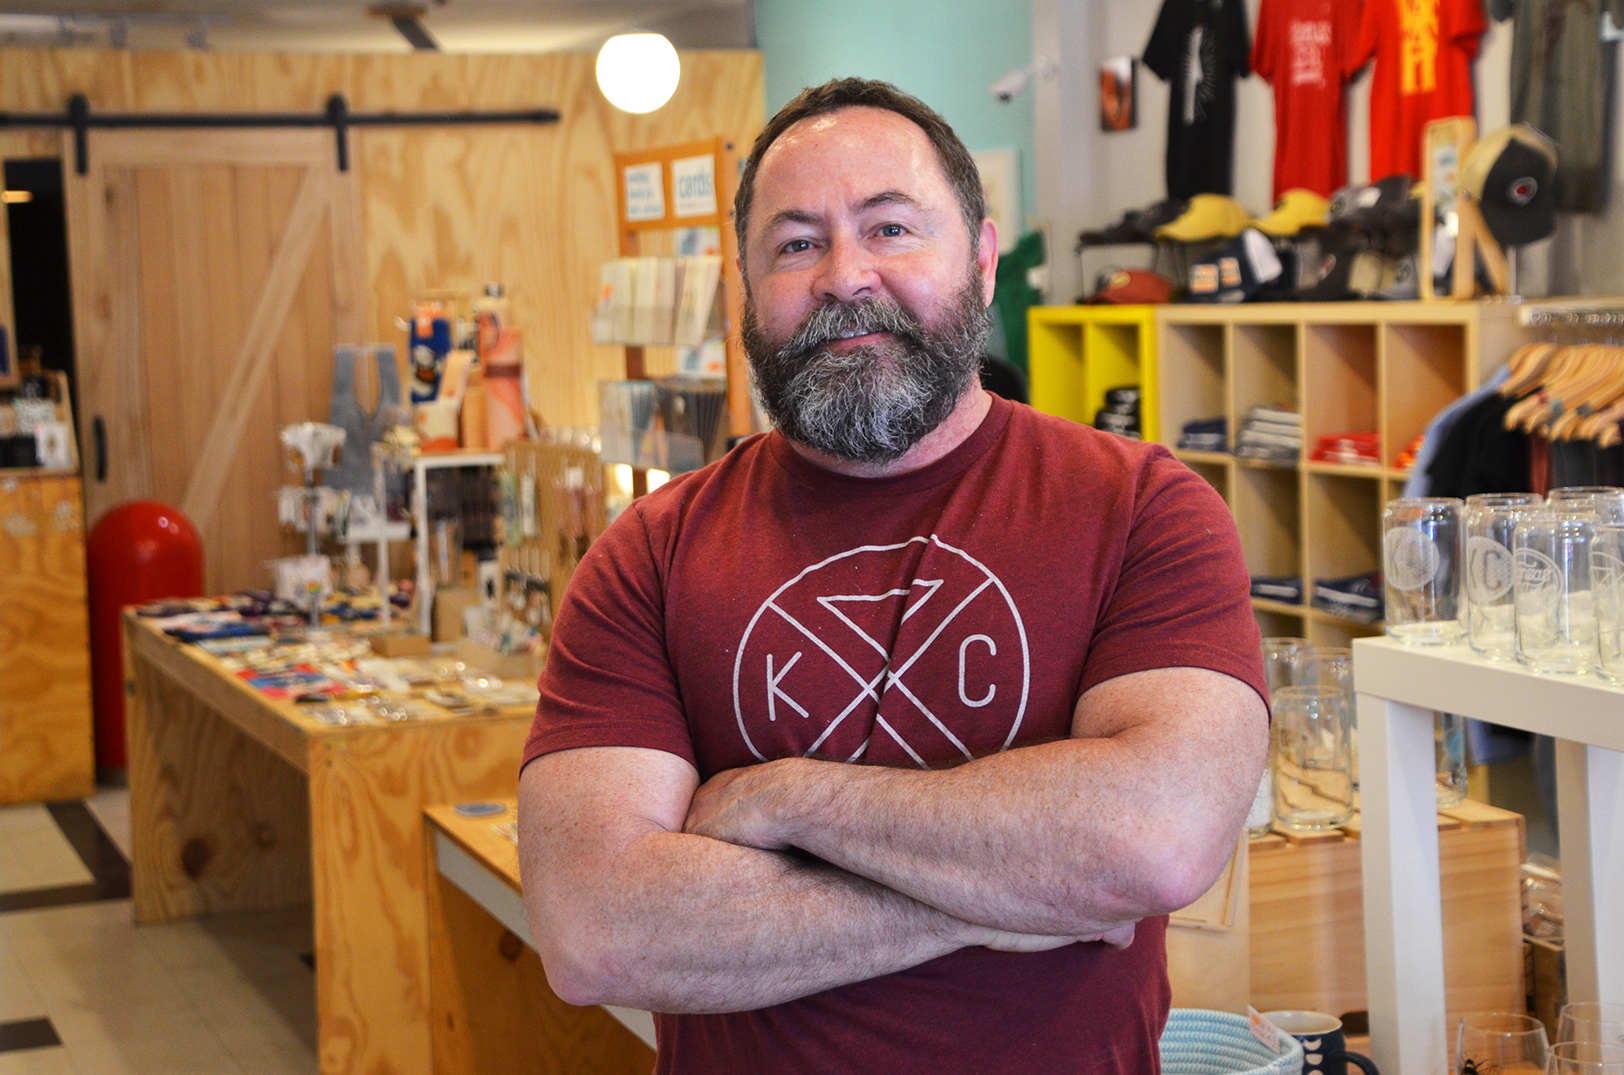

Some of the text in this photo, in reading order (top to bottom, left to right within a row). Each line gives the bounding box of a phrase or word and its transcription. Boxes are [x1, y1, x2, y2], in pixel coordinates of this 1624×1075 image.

[678, 166, 713, 199] cards
[766, 634, 996, 721] K C
